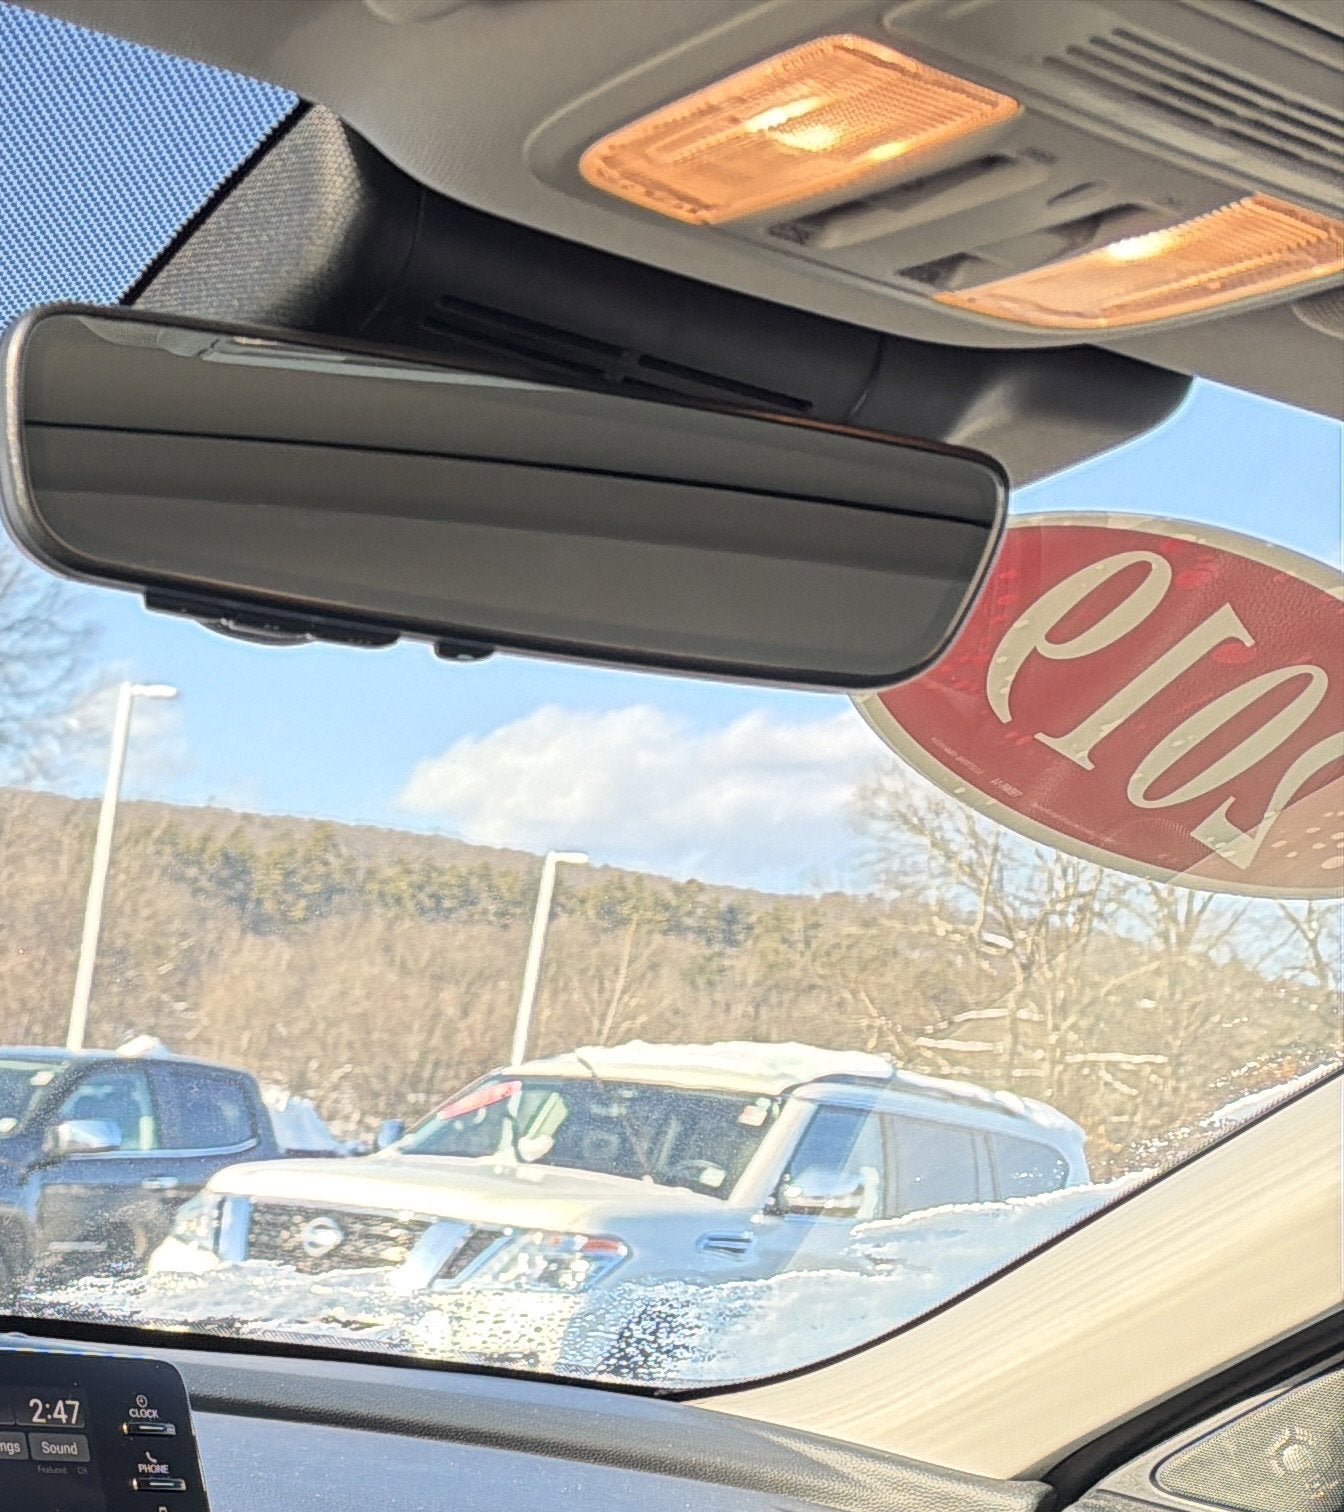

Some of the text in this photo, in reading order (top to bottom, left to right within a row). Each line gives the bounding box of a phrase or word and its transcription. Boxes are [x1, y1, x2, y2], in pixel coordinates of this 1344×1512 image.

[29, 1398, 80, 1424] 2:47
[128, 1408, 159, 1419] CLOCK
[41, 1441, 79, 1455] Sound
[138, 1463, 170, 1474] PHONE
